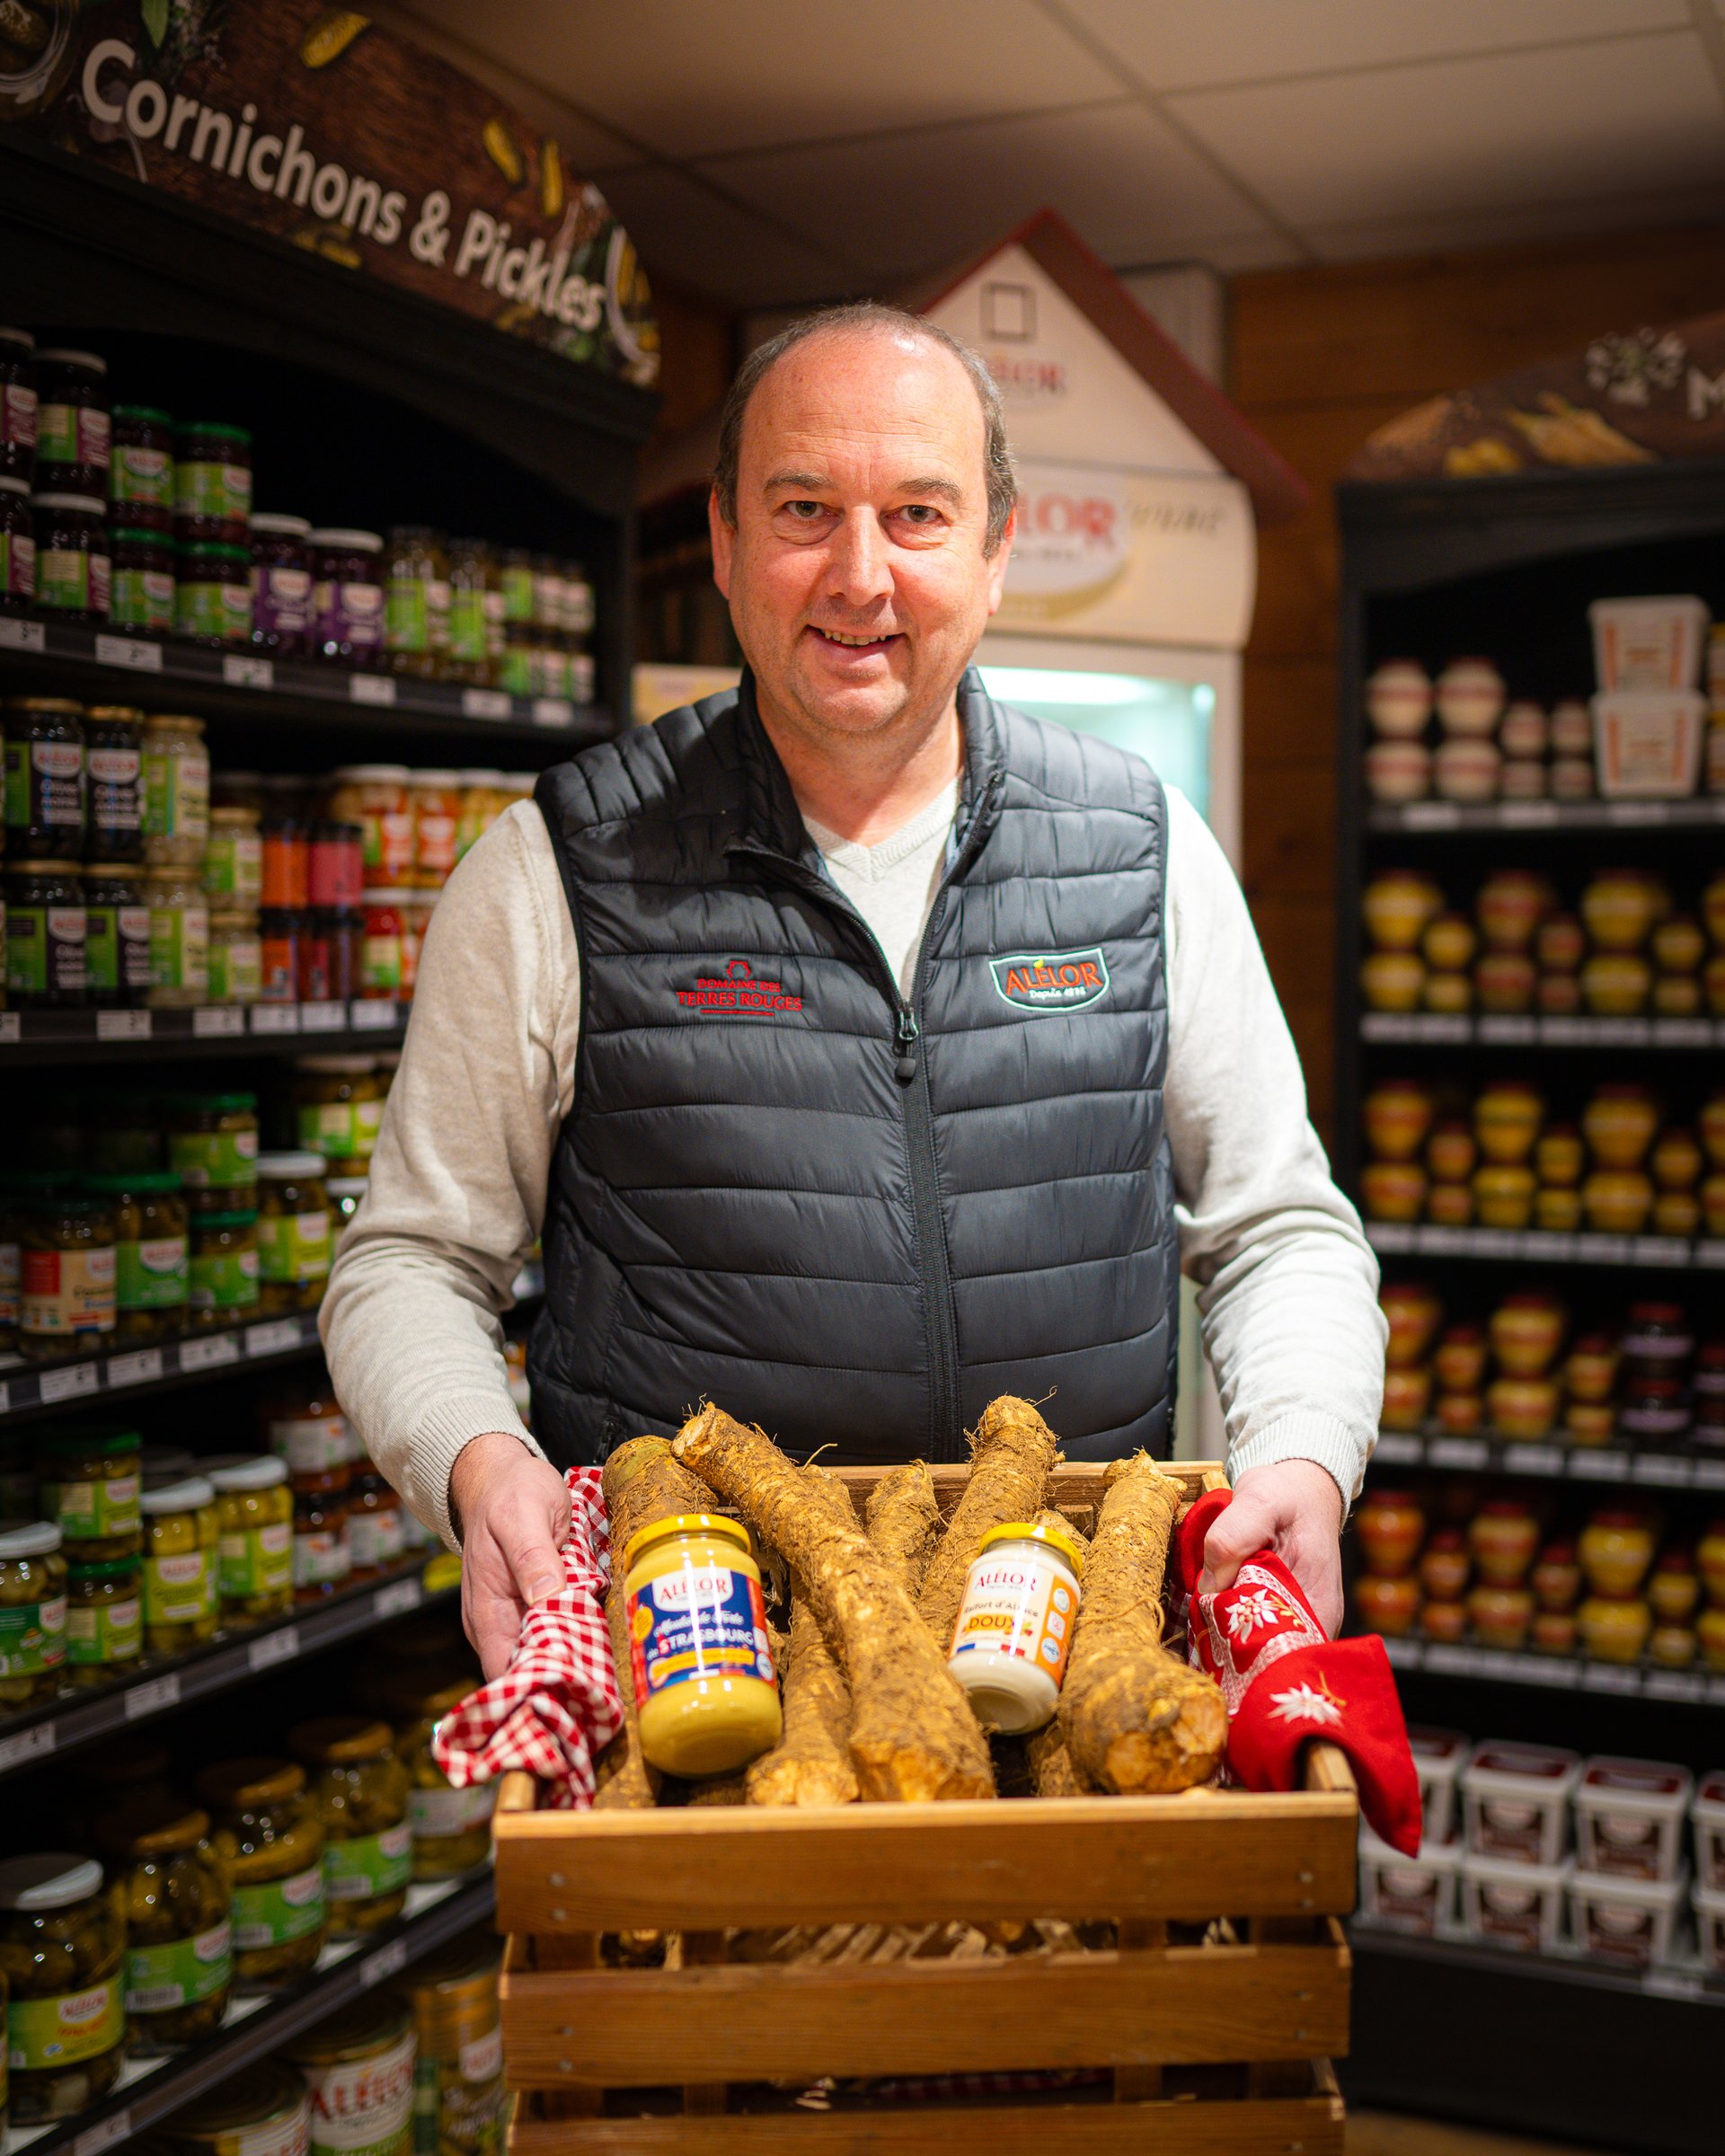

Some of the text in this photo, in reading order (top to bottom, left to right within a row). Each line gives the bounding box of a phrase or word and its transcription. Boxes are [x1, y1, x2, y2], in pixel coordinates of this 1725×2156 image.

[82, 39, 606, 331] Cornichons & Pickles
[697, 978, 781, 993] DOMAINE DES
[1029, 988, 1062, 1000] Depuis
[677, 992, 802, 1012] TERRES ROUGES
[659, 1577, 728, 1604] ALÉOR
[995, 1600, 1039, 1618] d'Alace
